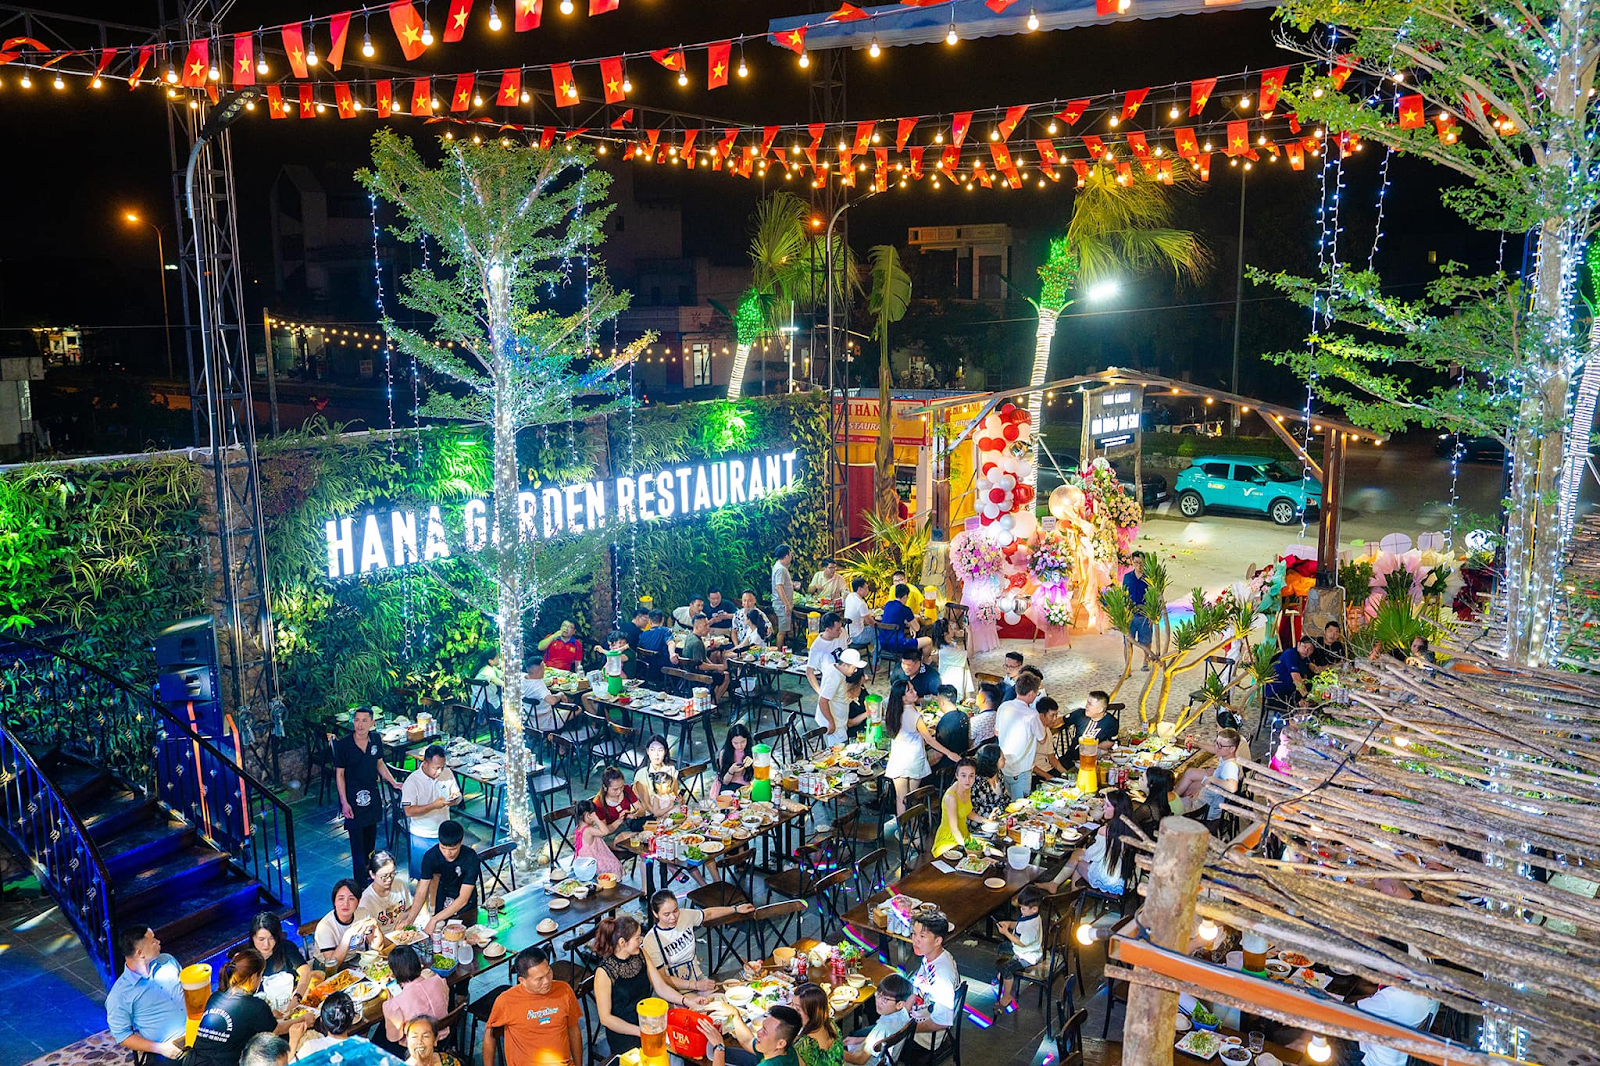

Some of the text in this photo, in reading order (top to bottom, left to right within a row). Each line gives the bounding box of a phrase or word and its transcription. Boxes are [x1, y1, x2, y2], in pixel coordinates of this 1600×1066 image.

[840, 421, 897, 432] RSTAURAT
[325, 505, 451, 578] HANA
[616, 452, 797, 523] RESTAURANT
[664, 928, 695, 958] URBAN
[672, 1030, 691, 1045] UBA
